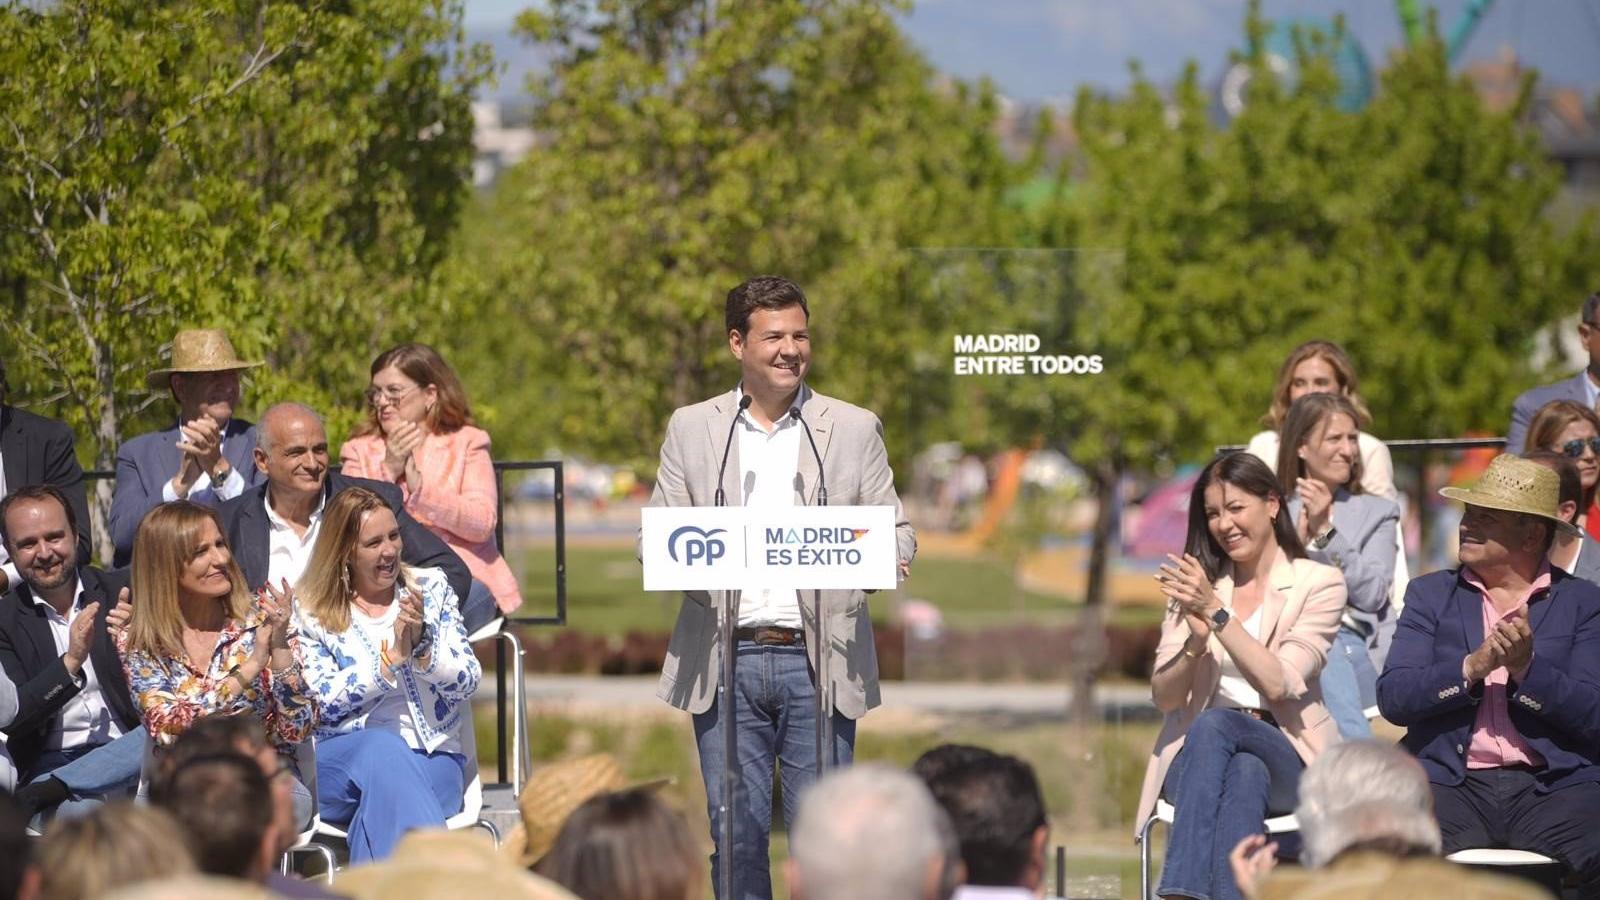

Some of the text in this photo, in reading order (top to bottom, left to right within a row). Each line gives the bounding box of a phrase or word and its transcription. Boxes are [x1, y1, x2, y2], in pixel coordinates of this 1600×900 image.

[954, 334, 1041, 353] MADRID
[954, 354, 1104, 375] ENTRE TODOS
[765, 527, 856, 545] MADRID
[765, 545, 862, 566] ES ÉXITO
